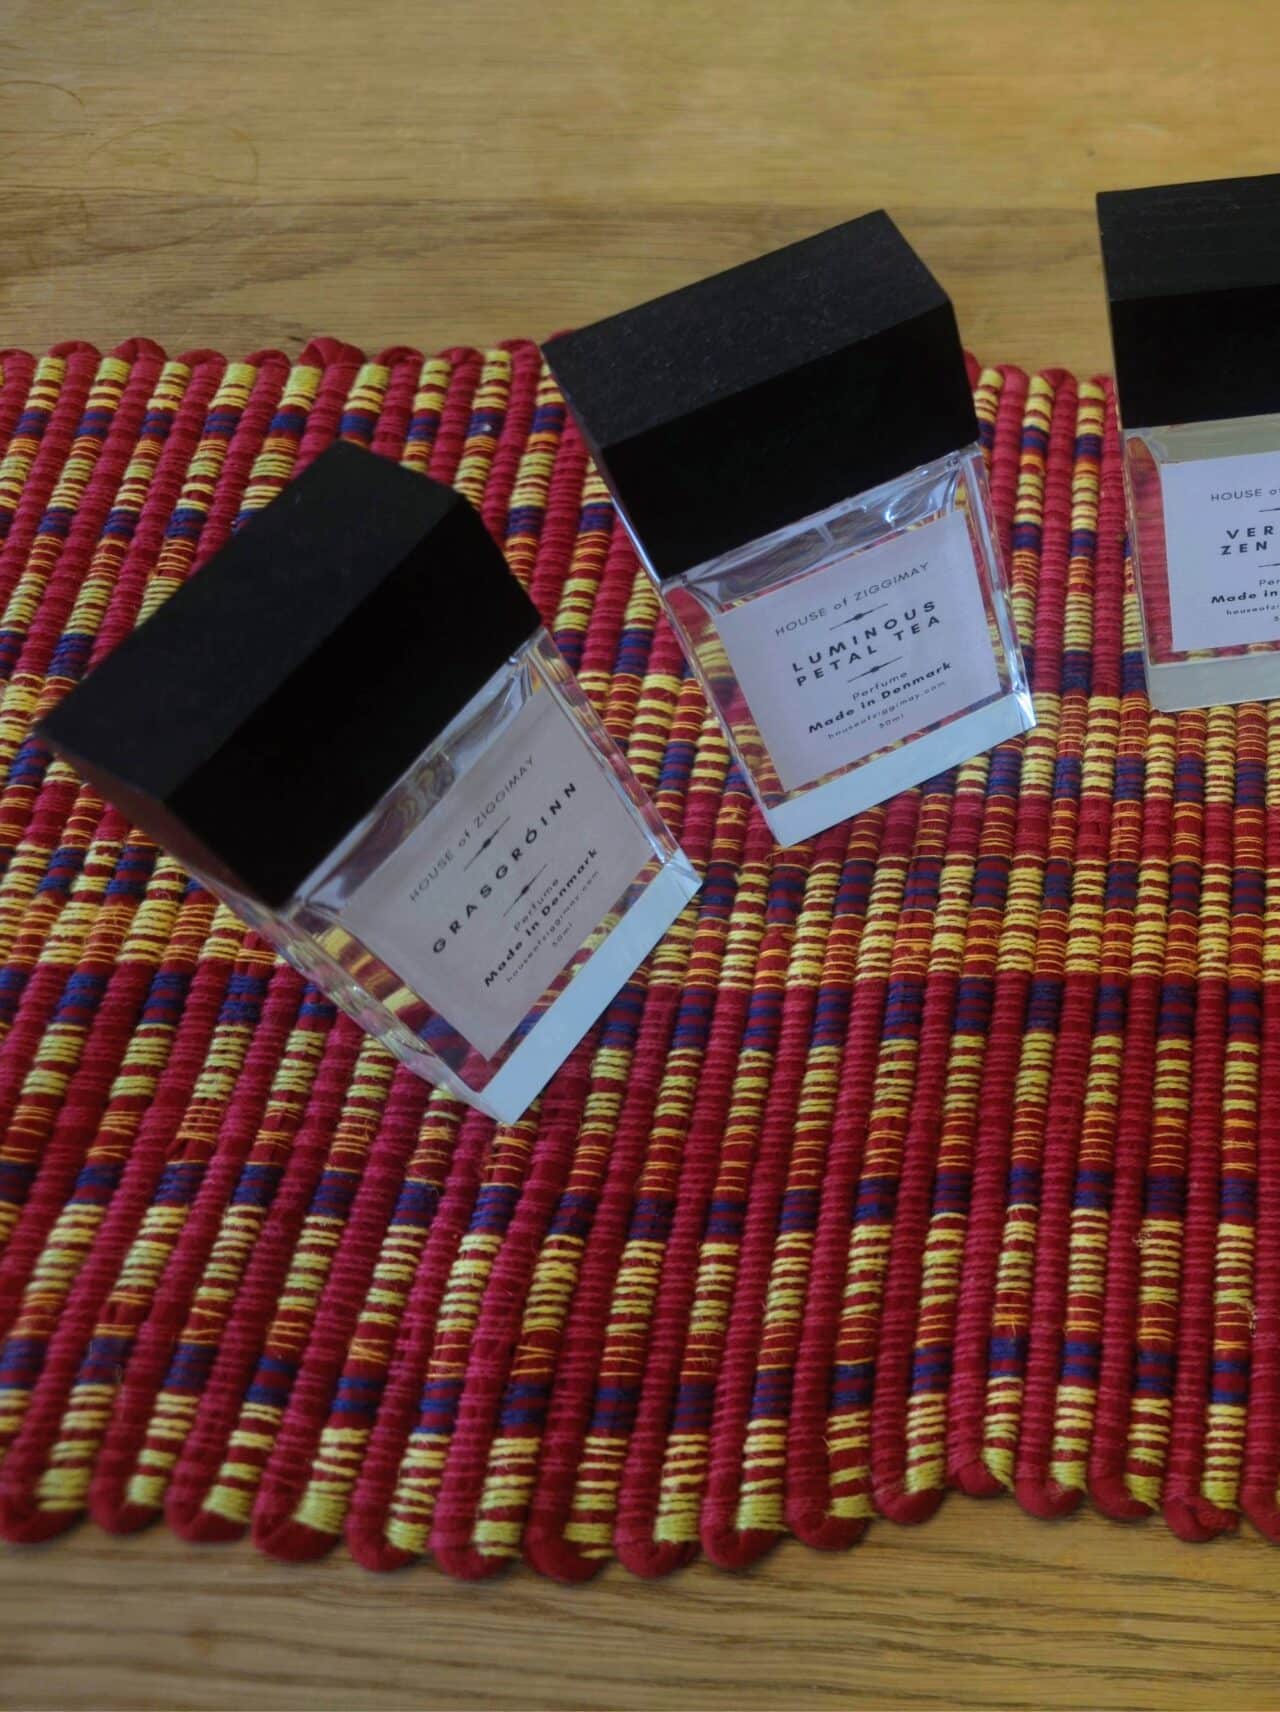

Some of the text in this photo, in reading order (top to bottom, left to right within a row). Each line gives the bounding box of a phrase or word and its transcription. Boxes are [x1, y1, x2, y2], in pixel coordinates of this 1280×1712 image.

[1210, 489, 1262, 501] HOUSE
[1221, 541, 1267, 555] ZEN
[775, 561, 929, 637] HOUSE of ZIGGIMAY
[1211, 592, 1256, 604] Made
[1264, 590, 1278, 598] in
[792, 601, 936, 672] LUMINOUS
[796, 616, 940, 686] PETAL TEA
[808, 662, 952, 733] Made in Denmark
[852, 672, 908, 700] Perfume
[409, 755, 535, 902] HOUSE of ZIGGIMAY
[432, 783, 577, 953] GRASGRÓINN
[484, 940, 523, 987] Made
[541, 849, 597, 916] Denmark
[514, 878, 559, 931] Perfume
